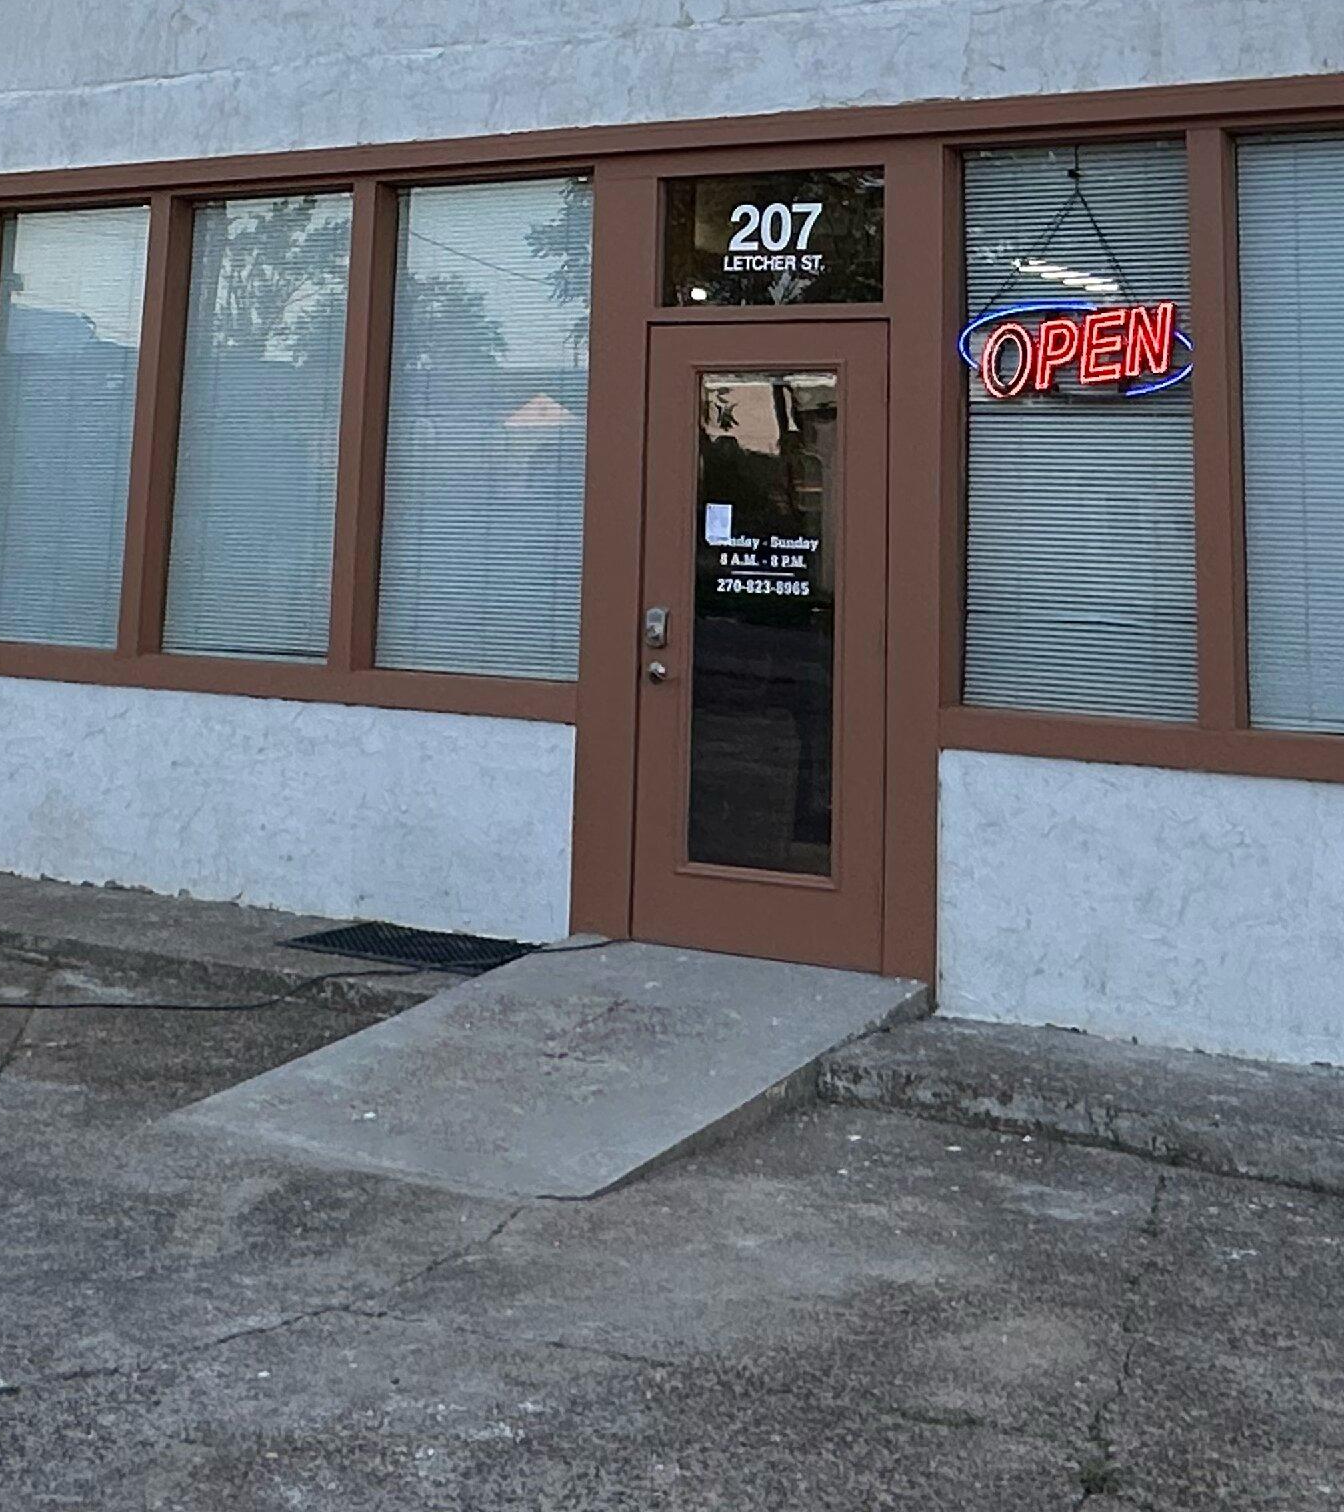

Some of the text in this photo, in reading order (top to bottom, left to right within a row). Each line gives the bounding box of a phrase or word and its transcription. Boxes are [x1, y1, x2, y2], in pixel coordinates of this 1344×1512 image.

[728, 202, 824, 252] 207
[723, 253, 826, 274] LETCHER ST.
[981, 300, 1175, 399] OPEN
[770, 535, 819, 552] Sunday
